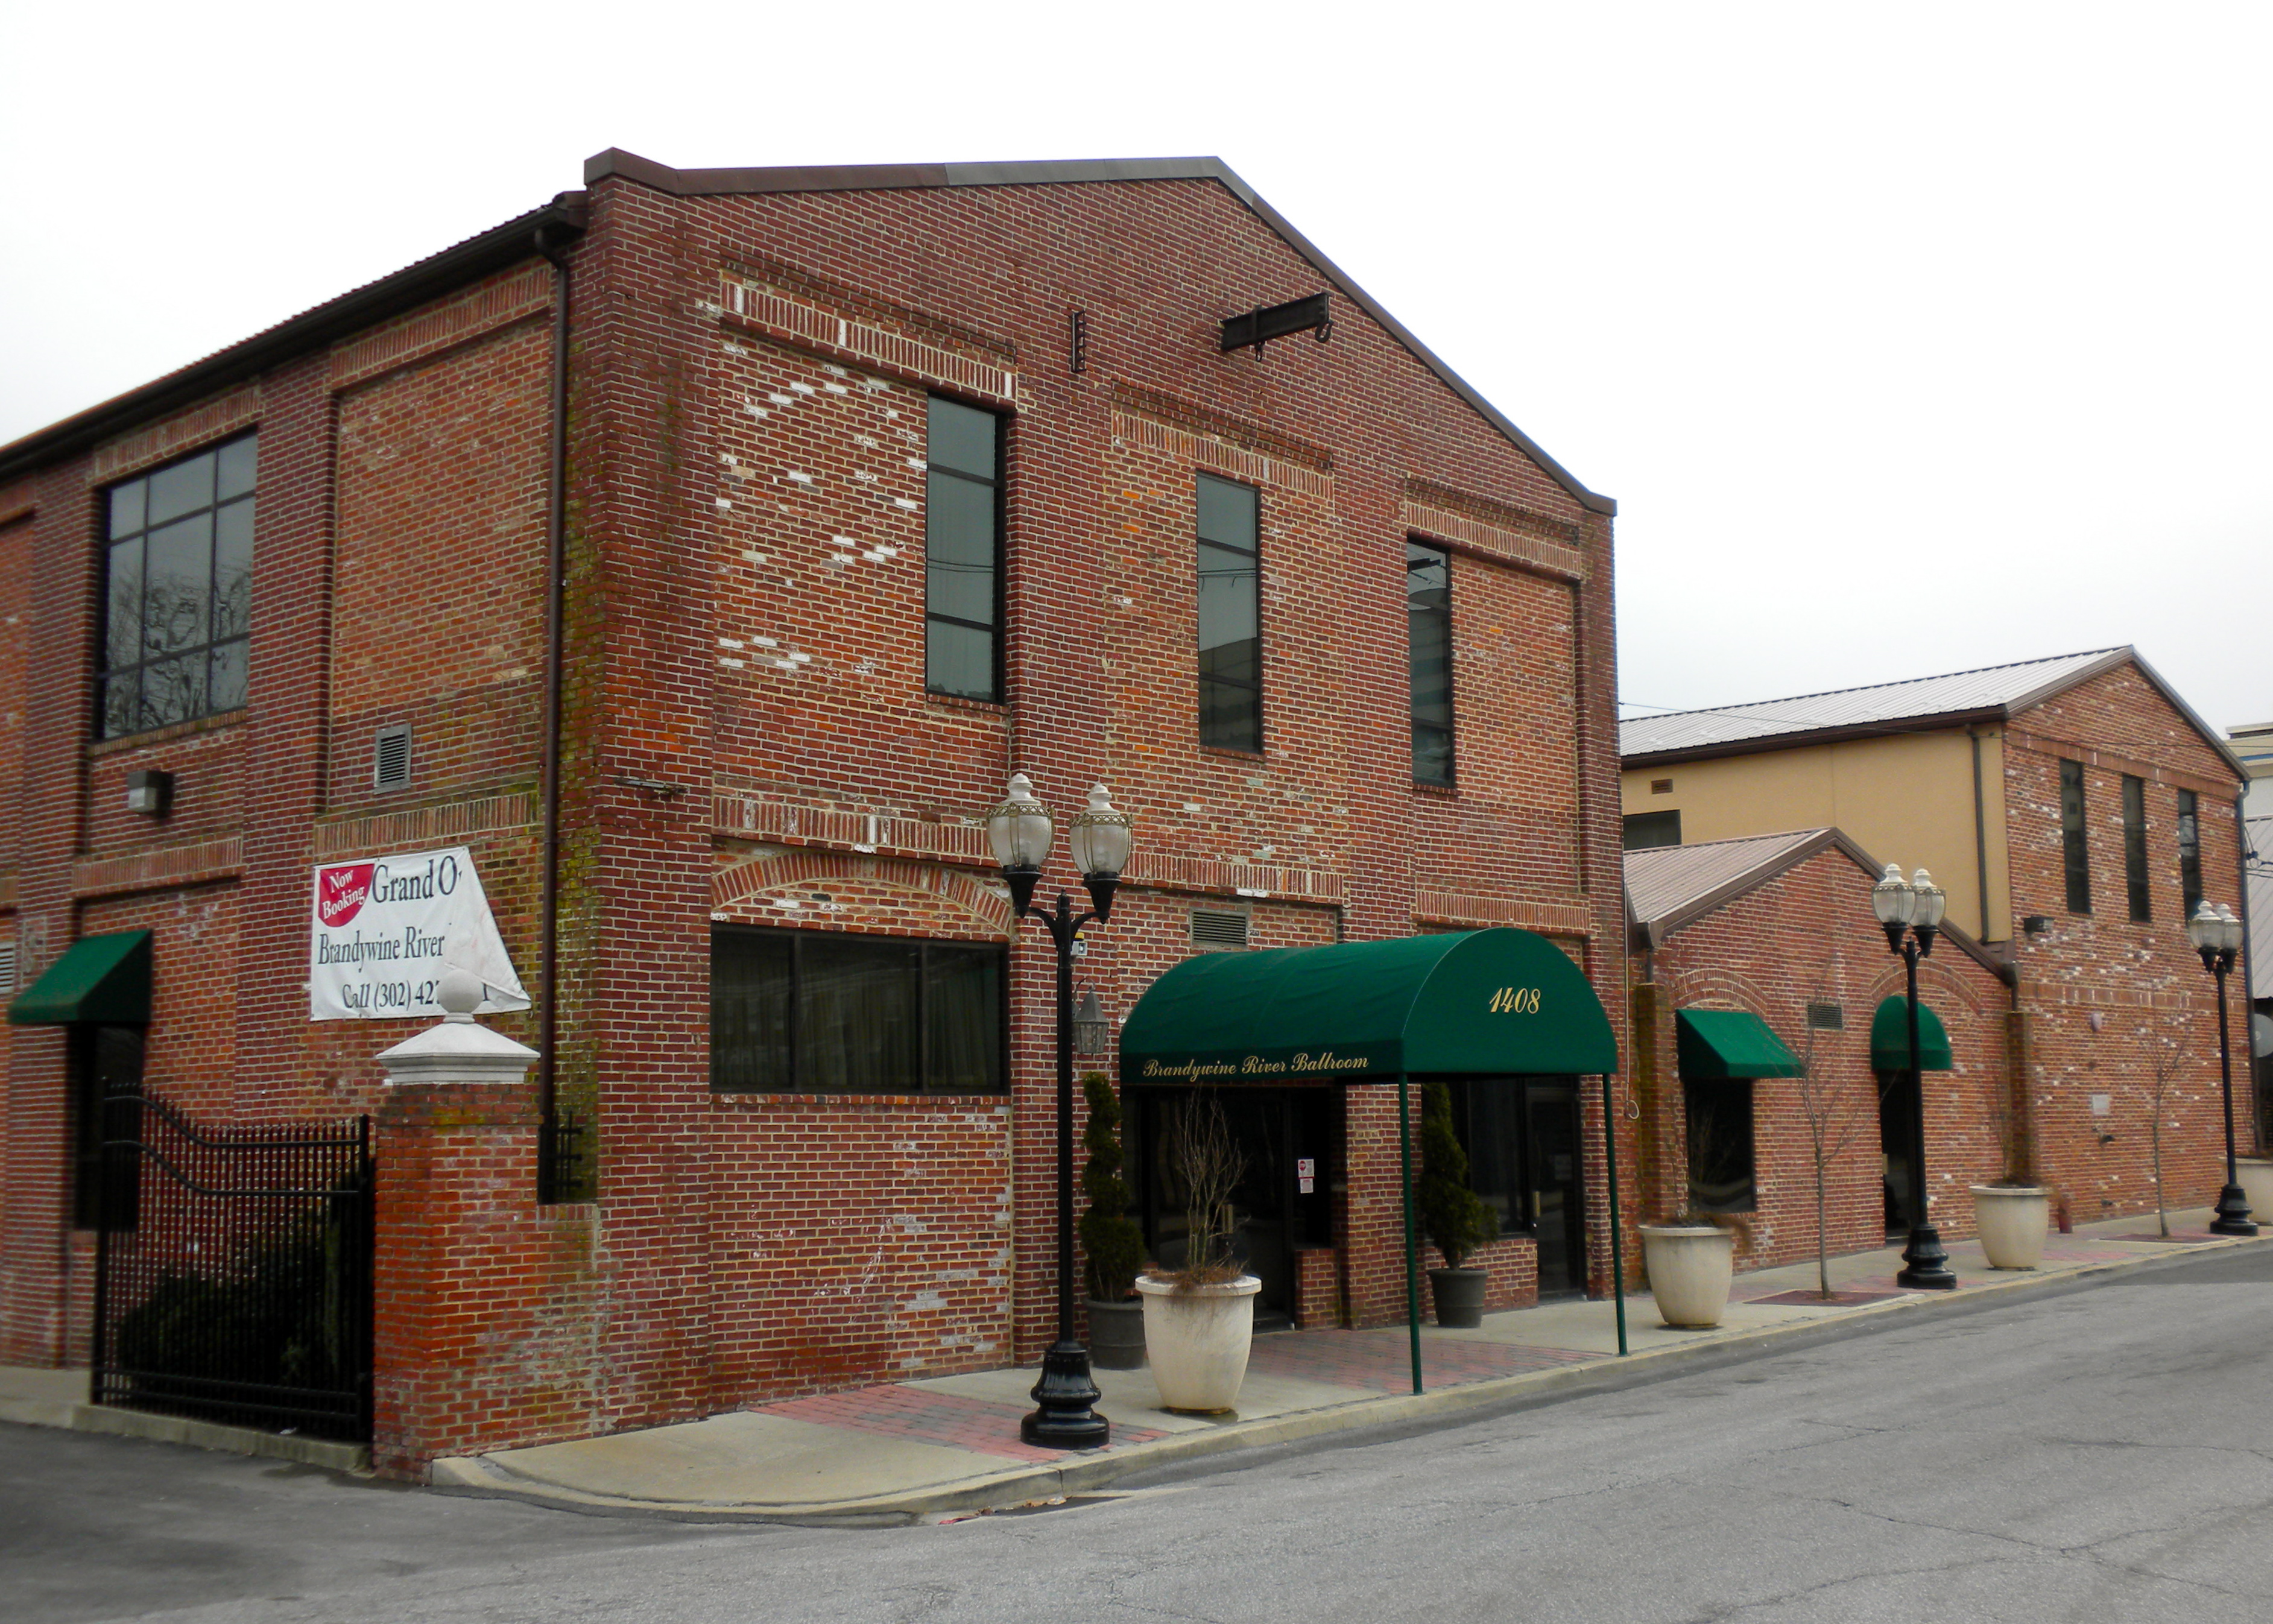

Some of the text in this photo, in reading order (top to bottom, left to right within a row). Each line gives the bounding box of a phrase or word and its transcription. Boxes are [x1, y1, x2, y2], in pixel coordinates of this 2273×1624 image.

[329, 870, 353, 894] Now
[372, 855, 463, 903] Grand O
[322, 886, 365, 920] Booking
[318, 926, 445, 973] Brandywine River
[342, 983, 371, 1009] Call
[374, 980, 411, 1013] (302)
[1489, 987, 1541, 1014] 1408
[1143, 1052, 1370, 1082] Brandywine River Ballroom
